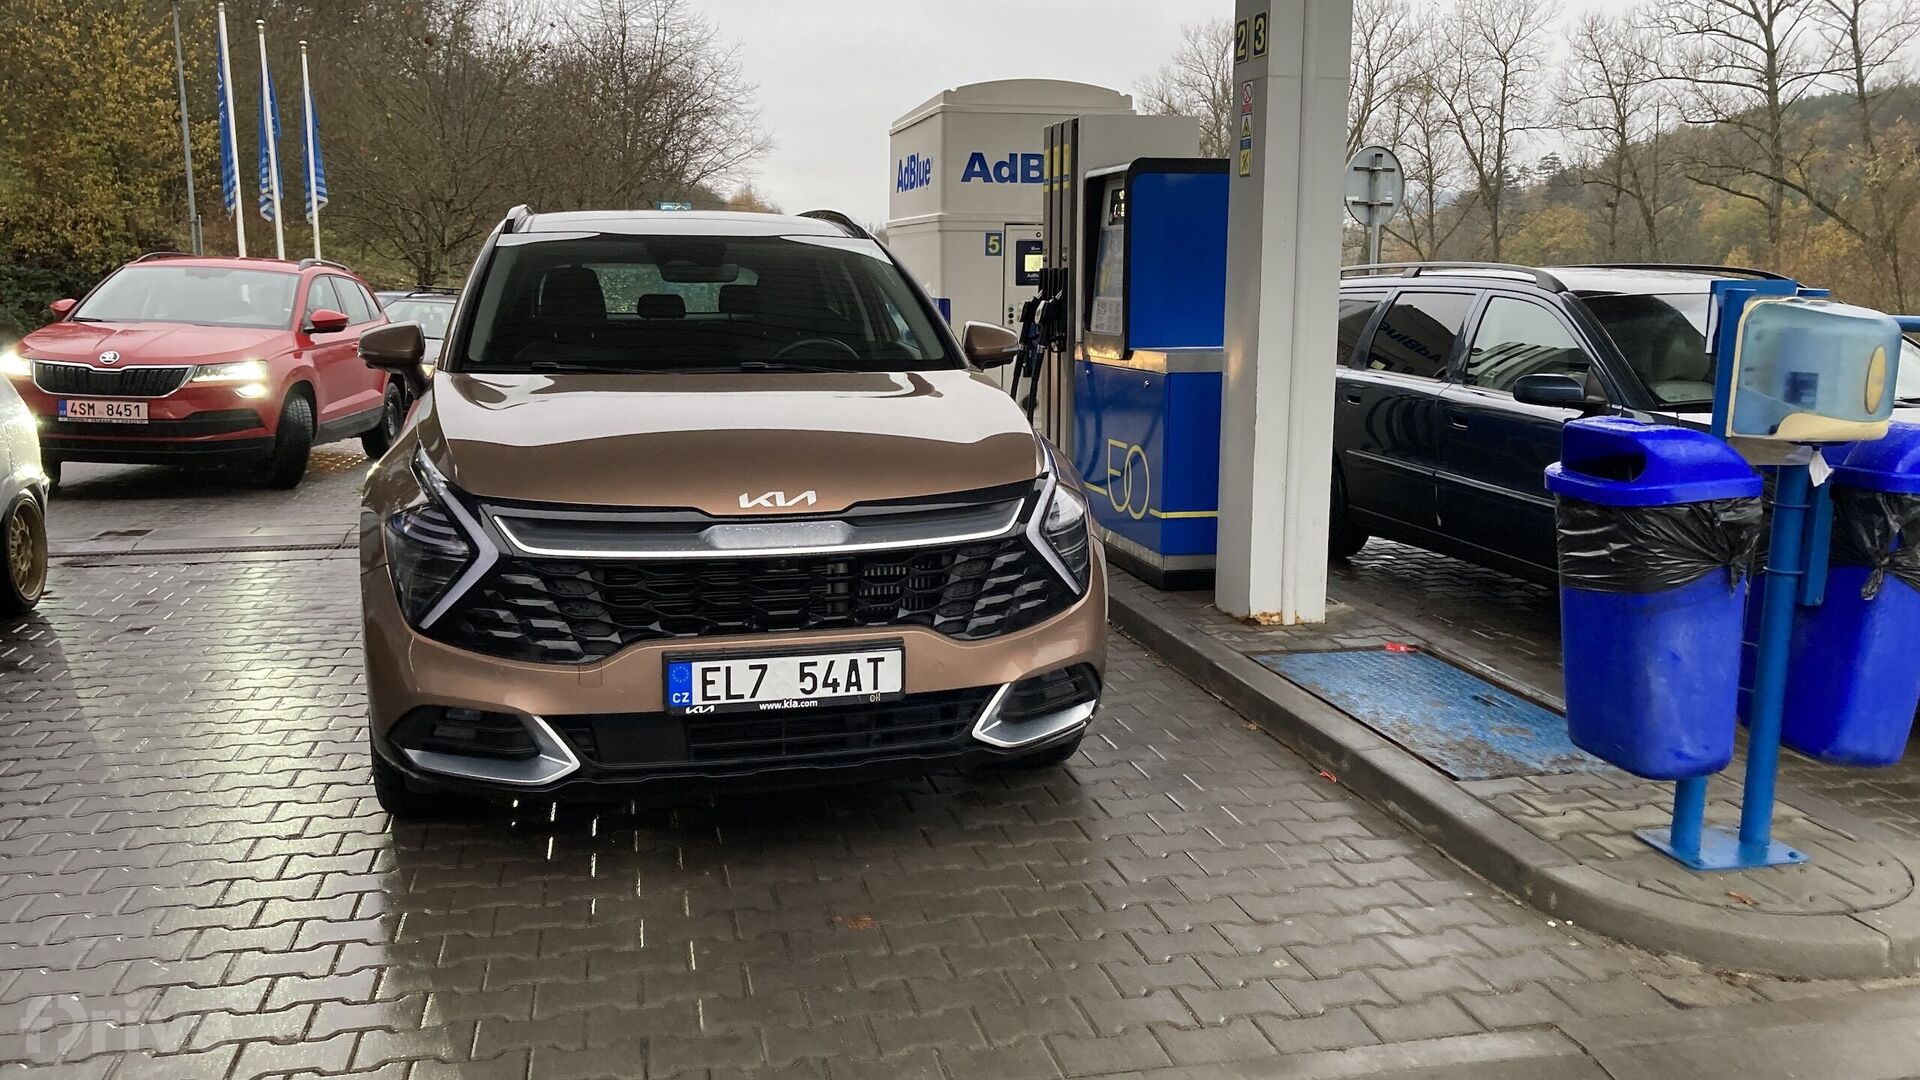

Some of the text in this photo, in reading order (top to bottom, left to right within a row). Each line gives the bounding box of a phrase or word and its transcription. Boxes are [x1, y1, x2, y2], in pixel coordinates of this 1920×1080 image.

[1237, 17, 1265, 57] 2 3
[896, 152, 931, 193] AdBlue
[961, 152, 1044, 184] AdB
[988, 235, 1000, 254] 5
[70, 402, 95, 416] 4SM
[106, 403, 140, 418] 8451
[739, 490, 817, 509] KIA
[701, 656, 885, 701] EL7 54AT
[672, 691, 690, 704] CZ
[759, 699, 818, 710] www.kia.com
